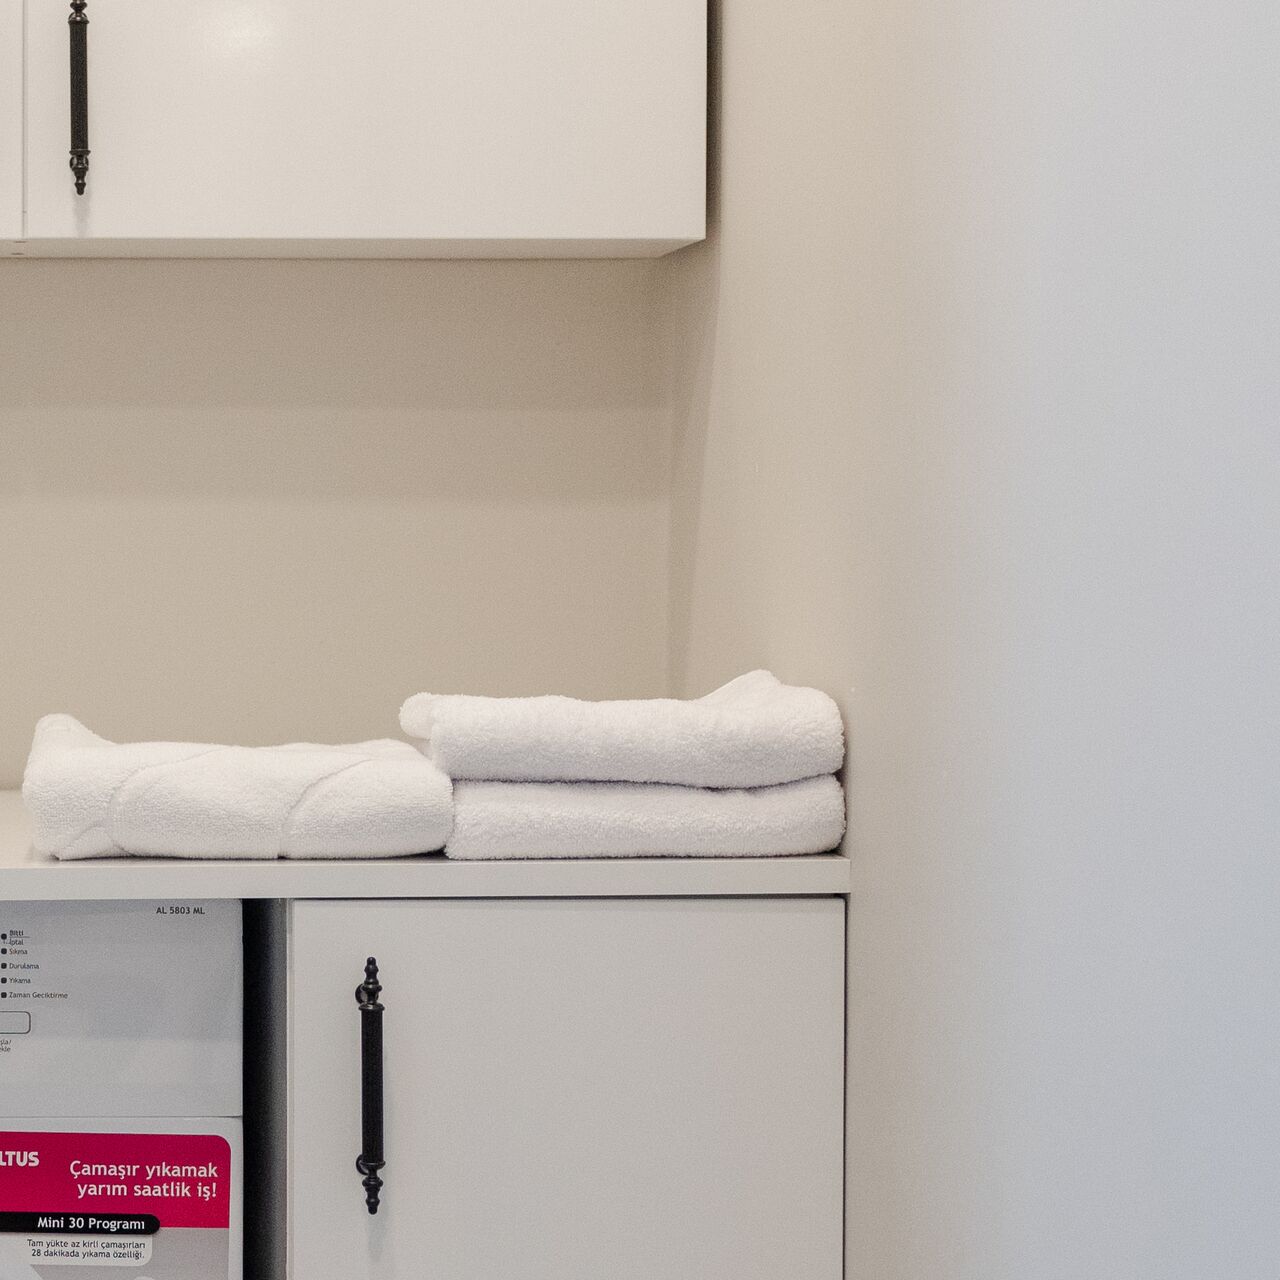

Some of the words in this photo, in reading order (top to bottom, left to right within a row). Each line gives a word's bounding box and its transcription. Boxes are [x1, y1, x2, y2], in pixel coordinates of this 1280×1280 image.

[156, 906, 167, 914] AL
[170, 906, 190, 914] 5803
[32, 991, 68, 999] Geciktirme
[70, 1161, 140, 1180] Çamaşır
[146, 1162, 218, 1180] yıkamak
[77, 1183, 128, 1199] yarım
[134, 1182, 190, 1197] saatlik
[197, 1183, 217, 1201] iş!
[37, 1217, 64, 1229] Mini
[69, 1218, 84, 1229] 30
[88, 1218, 145, 1232] Programı
[27, 1239, 44, 1247] Tam
[46, 1239, 68, 1249] yükte
[70, 1240, 80, 1248] az
[82, 1239, 99, 1248] kirli
[100, 1240, 145, 1251] çamaşırları
[31, 1249, 41, 1257] 28
[43, 1249, 80, 1258] dakikada
[82, 1249, 110, 1259] yıkama
[113, 1250, 145, 1261] özelliği.
